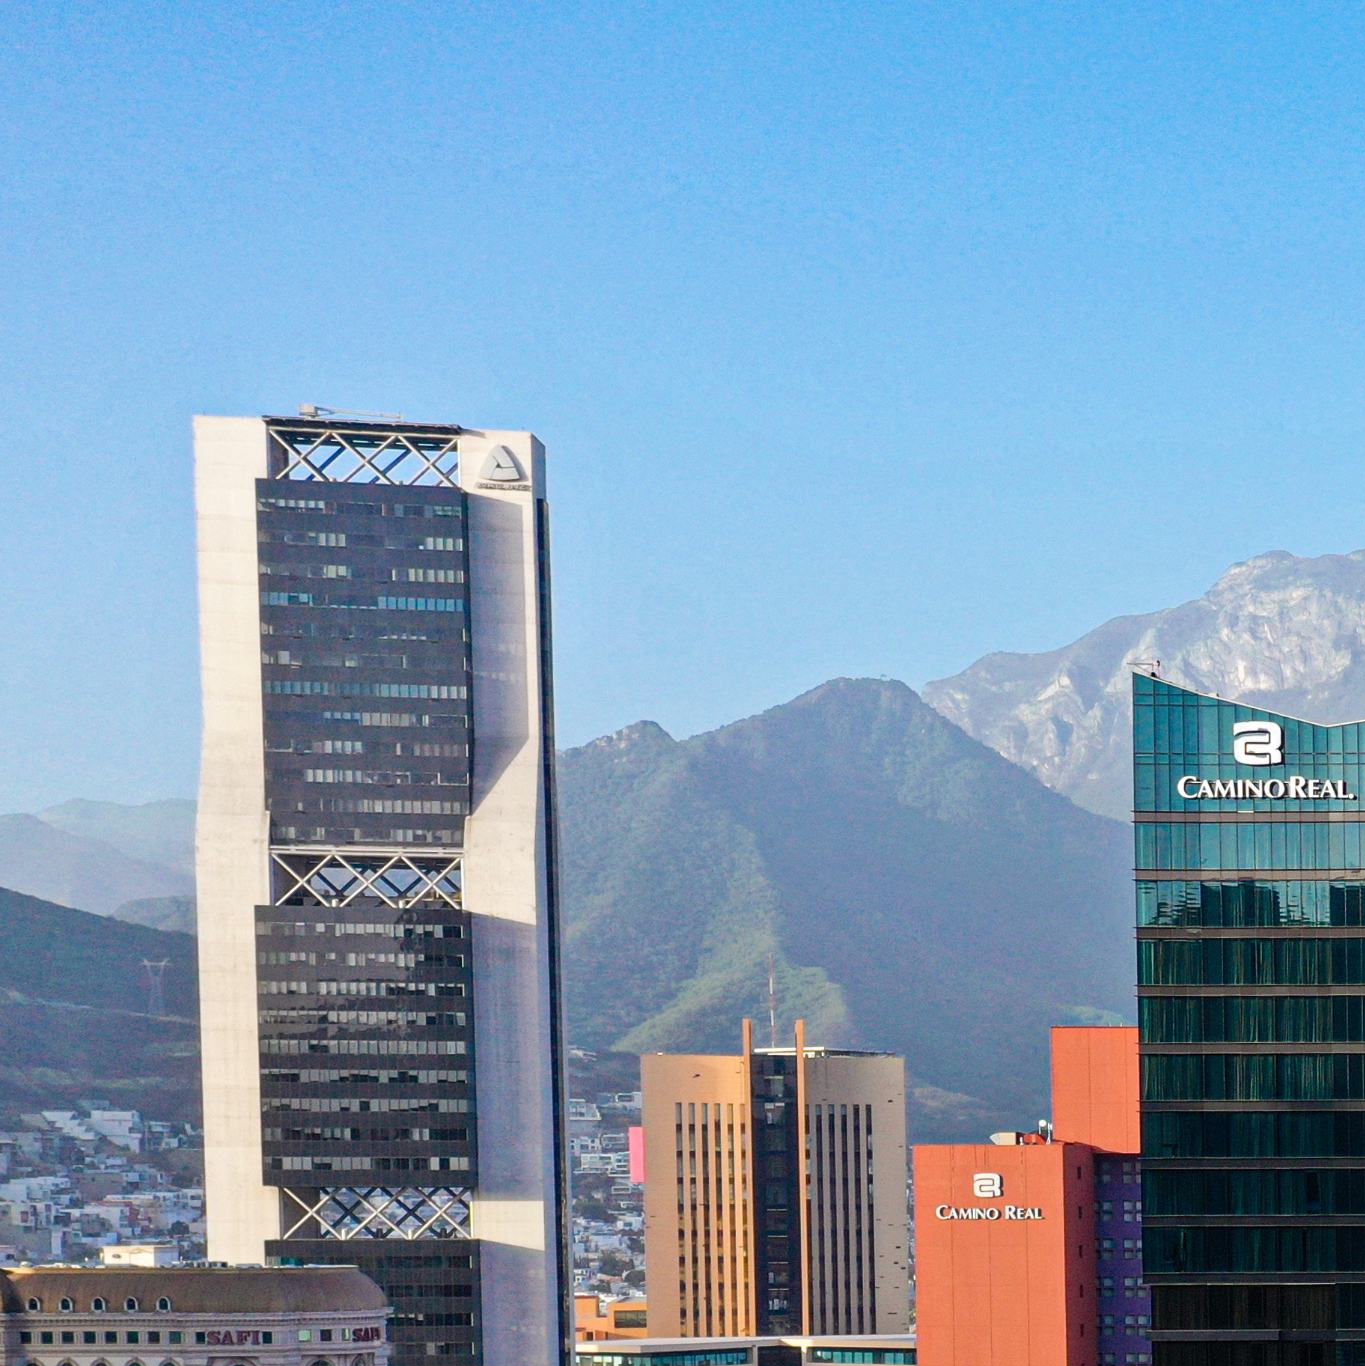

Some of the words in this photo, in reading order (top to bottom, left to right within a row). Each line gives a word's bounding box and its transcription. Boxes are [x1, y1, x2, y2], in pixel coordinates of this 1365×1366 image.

[1177, 776, 1286, 800] CAMINO
[935, 1204, 1001, 1221] CAMINO
[1004, 1204, 1043, 1220] REAL
[206, 1330, 261, 1346] SAFI
